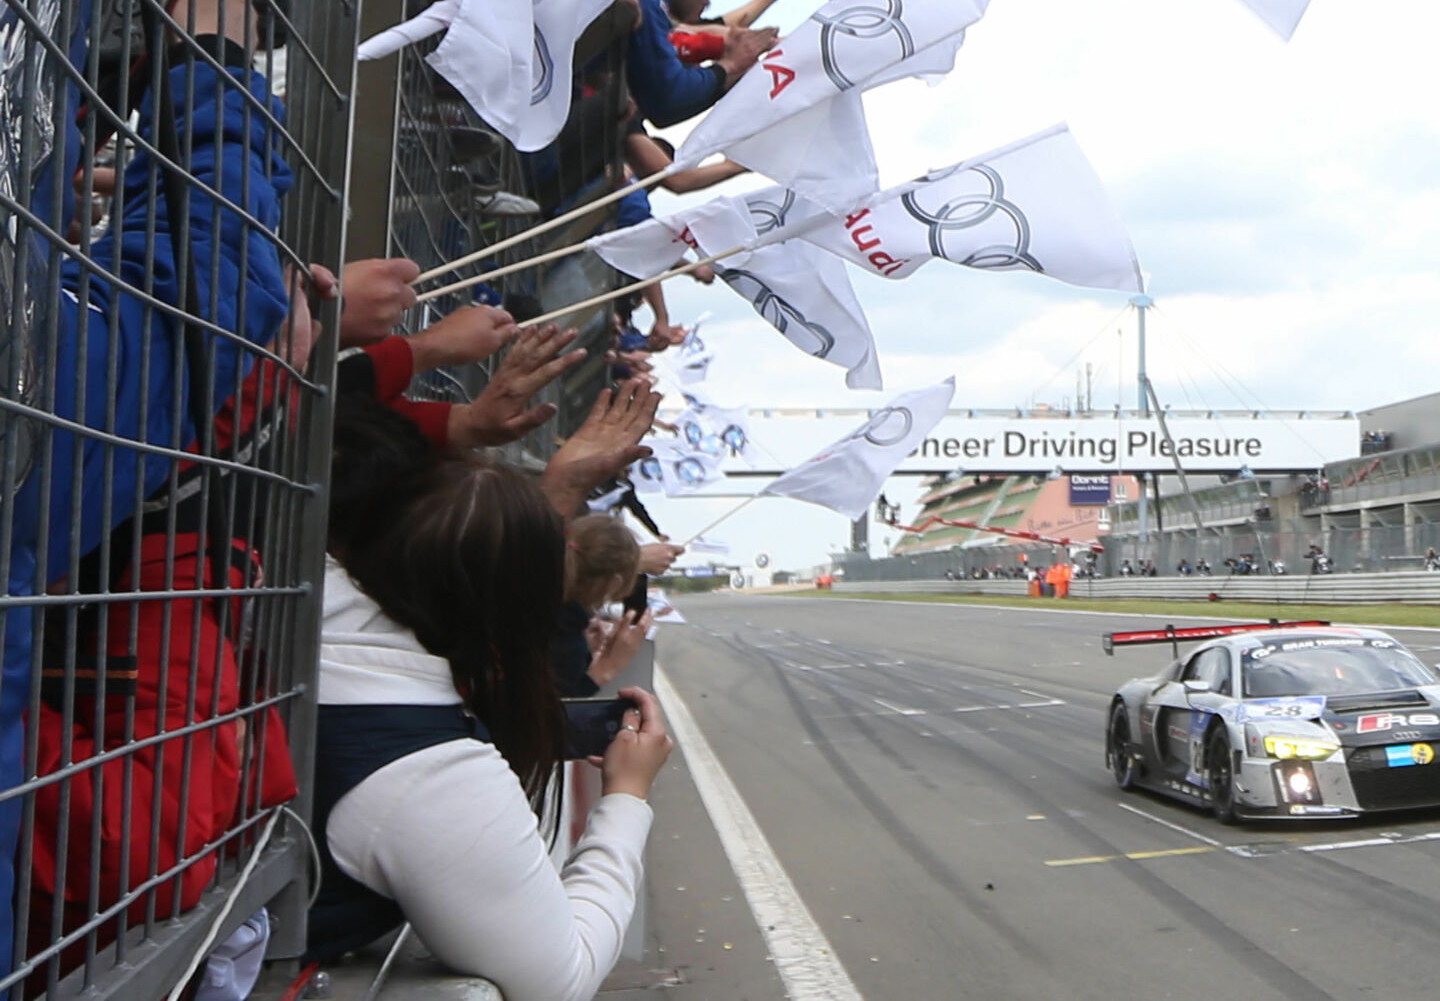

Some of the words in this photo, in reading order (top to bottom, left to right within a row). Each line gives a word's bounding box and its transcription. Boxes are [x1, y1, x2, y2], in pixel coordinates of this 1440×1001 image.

[1004, 431, 1117, 464] Driving
[1127, 431, 1262, 457] Pleasure
[1264, 704, 1303, 717] 28
[1375, 713, 1440, 729] R8
